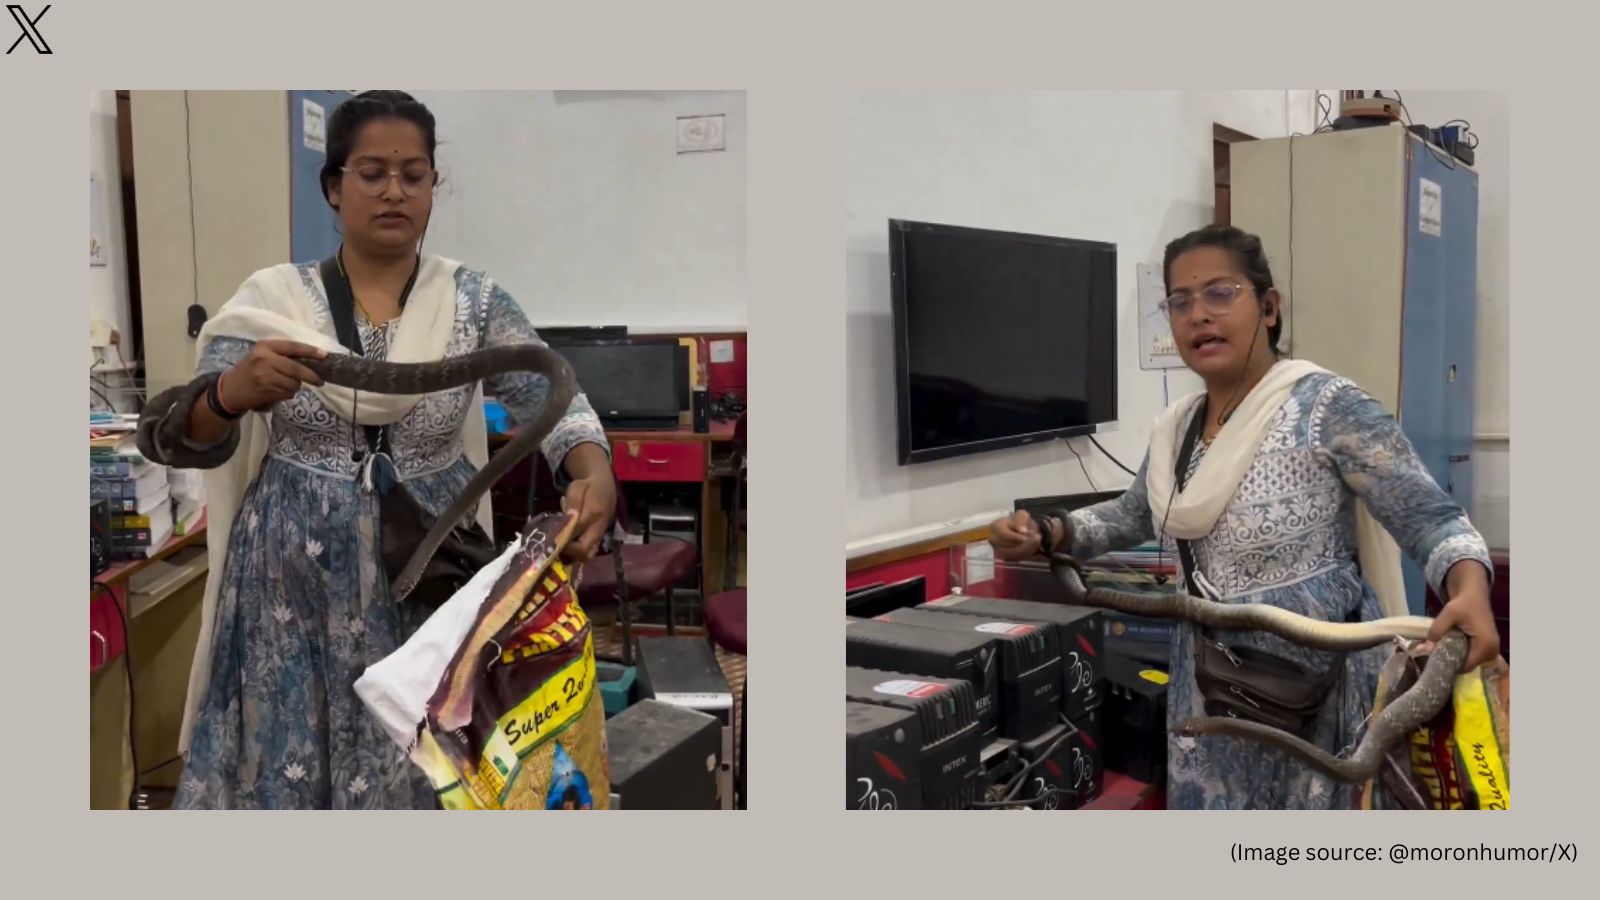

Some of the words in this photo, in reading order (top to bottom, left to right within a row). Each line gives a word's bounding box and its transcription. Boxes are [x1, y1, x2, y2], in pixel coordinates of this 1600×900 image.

[504, 700, 561, 746] Super
[942, 754, 968, 774] INTEX
[1472, 742, 1506, 810] Quality
